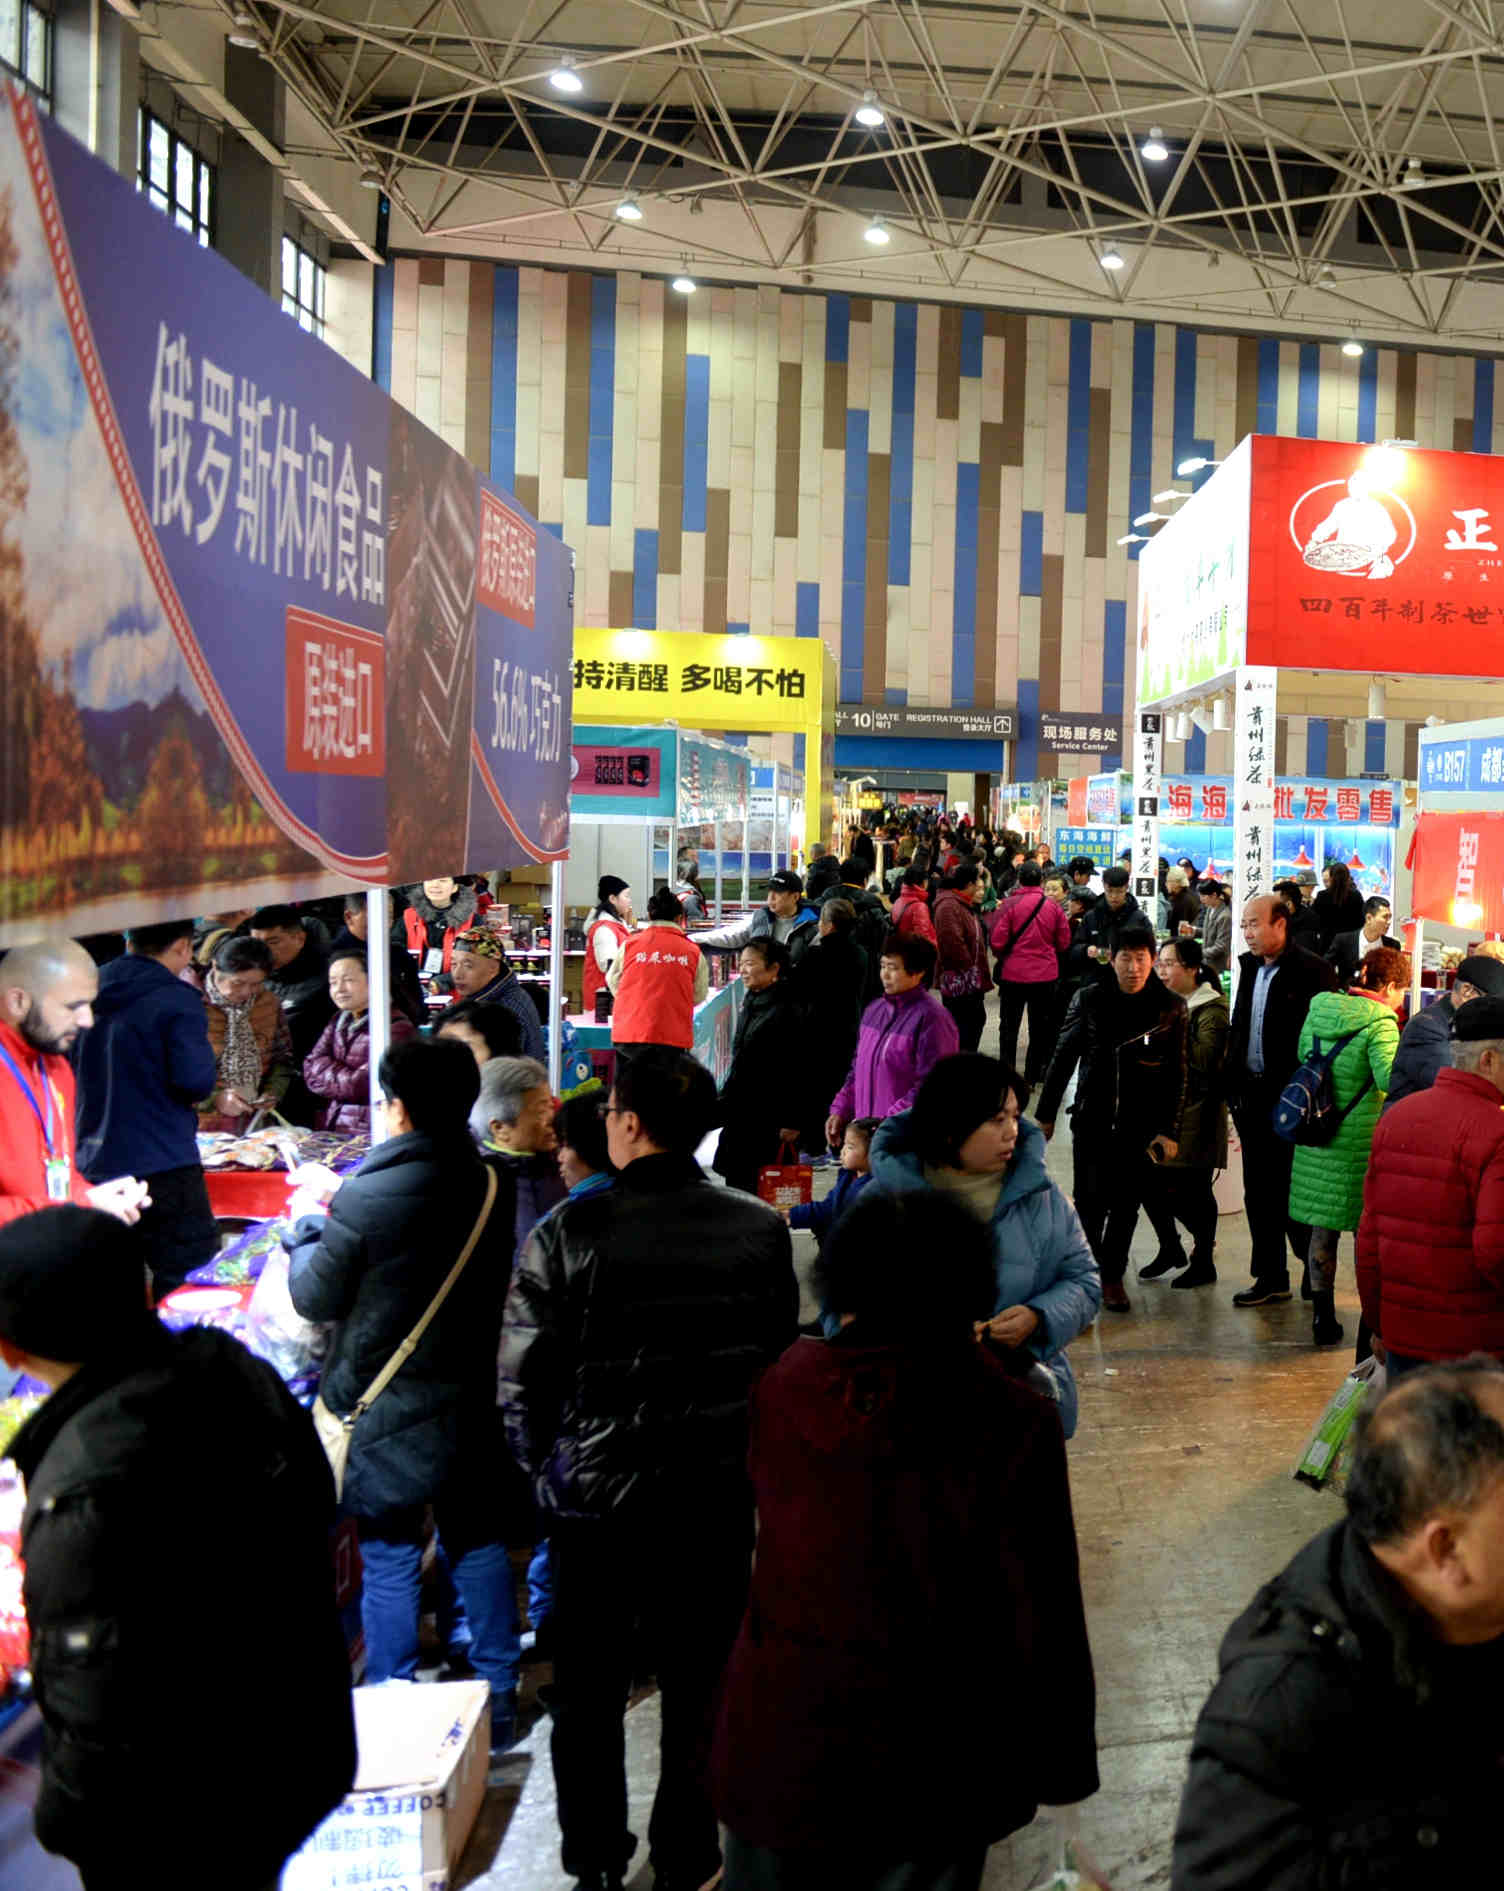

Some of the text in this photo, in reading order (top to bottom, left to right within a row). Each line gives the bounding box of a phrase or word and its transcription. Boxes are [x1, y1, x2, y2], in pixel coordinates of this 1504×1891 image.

[149, 321, 384, 605] 俄罗斯休闲食品
[574, 660, 805, 698] 持清醒 多喝不怕
[302, 641, 372, 760] 原装进口
[851, 712, 871, 728] 10
[875, 713, 900, 722] GATE
[906, 713, 968, 724] REGISTRATION
[970, 716, 992, 725] HALL
[1042, 725, 1118, 742] 现场服务处
[1051, 741, 1109, 751] Service Center
[1444, 751, 1465, 783] B157
